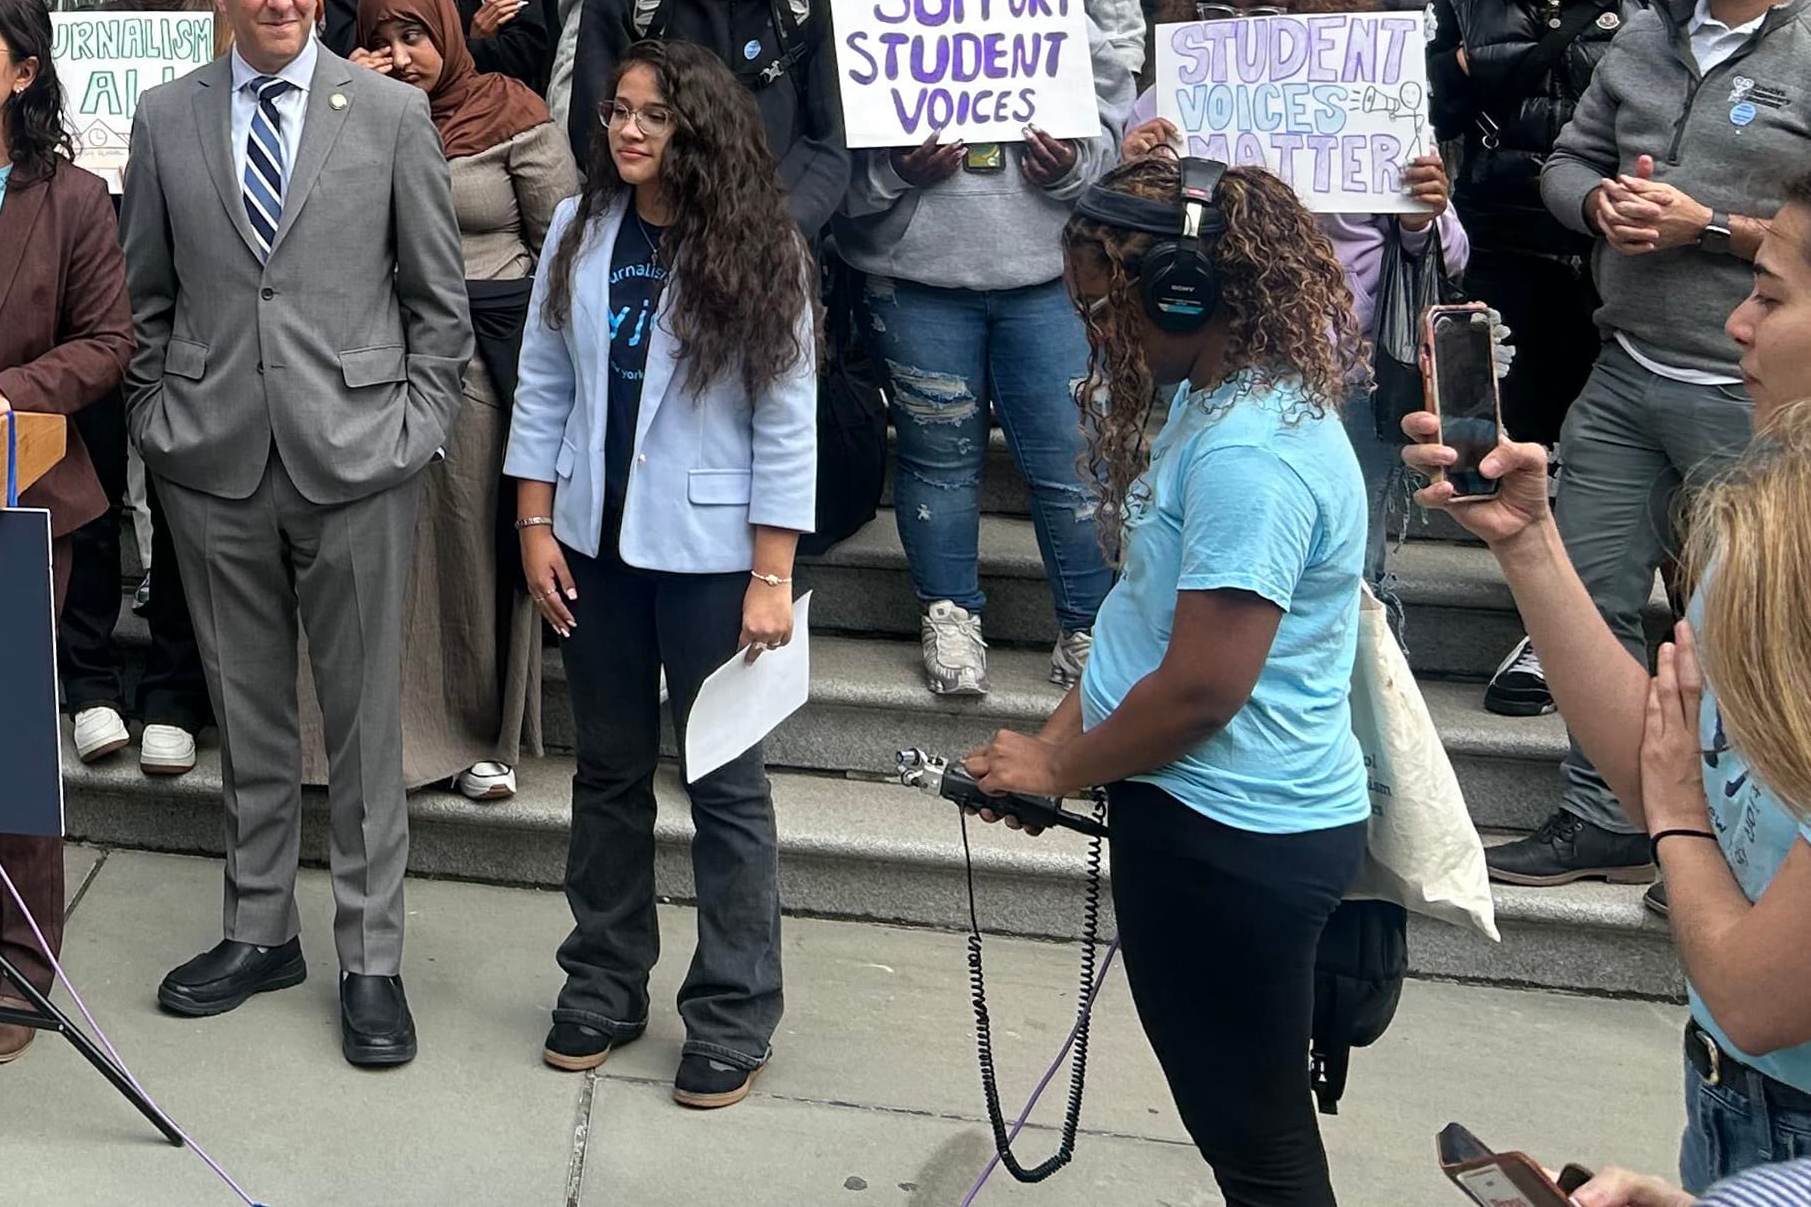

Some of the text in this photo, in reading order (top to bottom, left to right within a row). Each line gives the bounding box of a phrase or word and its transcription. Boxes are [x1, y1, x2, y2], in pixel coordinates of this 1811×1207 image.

[52, 17, 213, 64] URNALISM
[846, 31, 1069, 86] STUDENT
[1171, 15, 1416, 85] STUDENT
[890, 87, 1037, 135] VOICES
[1176, 82, 1349, 135] VOICES
[1188, 133, 1402, 195] MATTER
